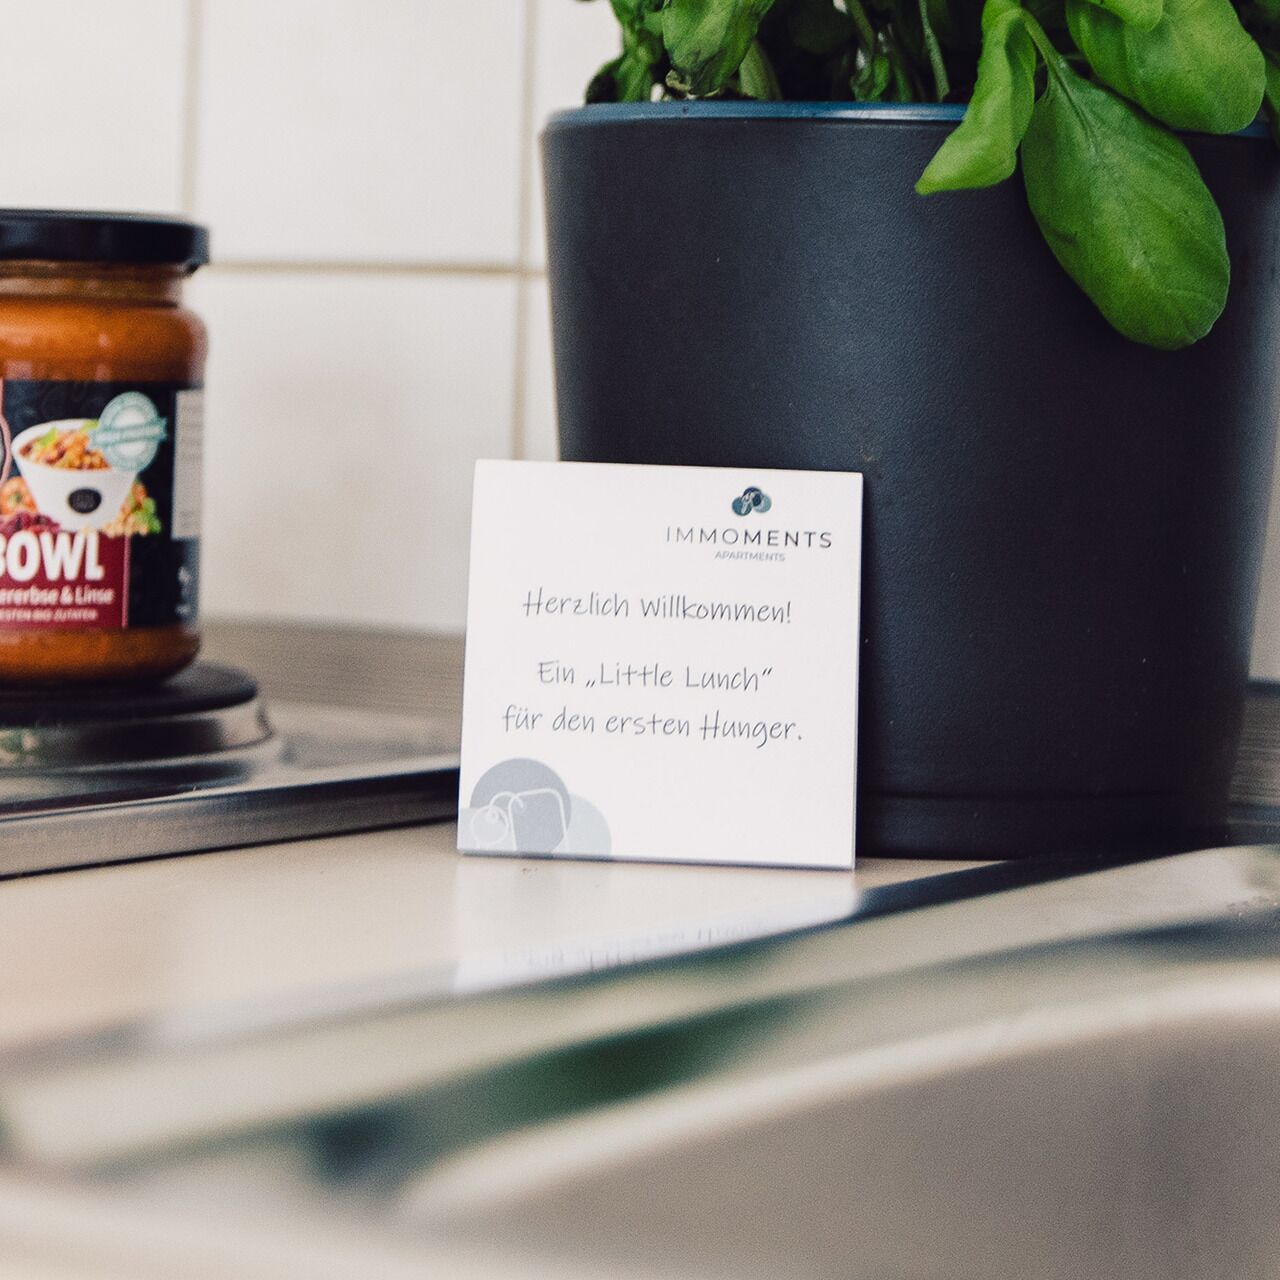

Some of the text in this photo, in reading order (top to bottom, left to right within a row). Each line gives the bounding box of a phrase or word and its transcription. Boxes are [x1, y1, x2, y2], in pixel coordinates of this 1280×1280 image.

[666, 526, 832, 549] IMMOMENTS
[714, 550, 787, 562] APARTMENTS
[523, 587, 629, 617] Herzlich
[537, 660, 575, 685] Ein
[502, 704, 803, 749] für den ersten Hunger.
